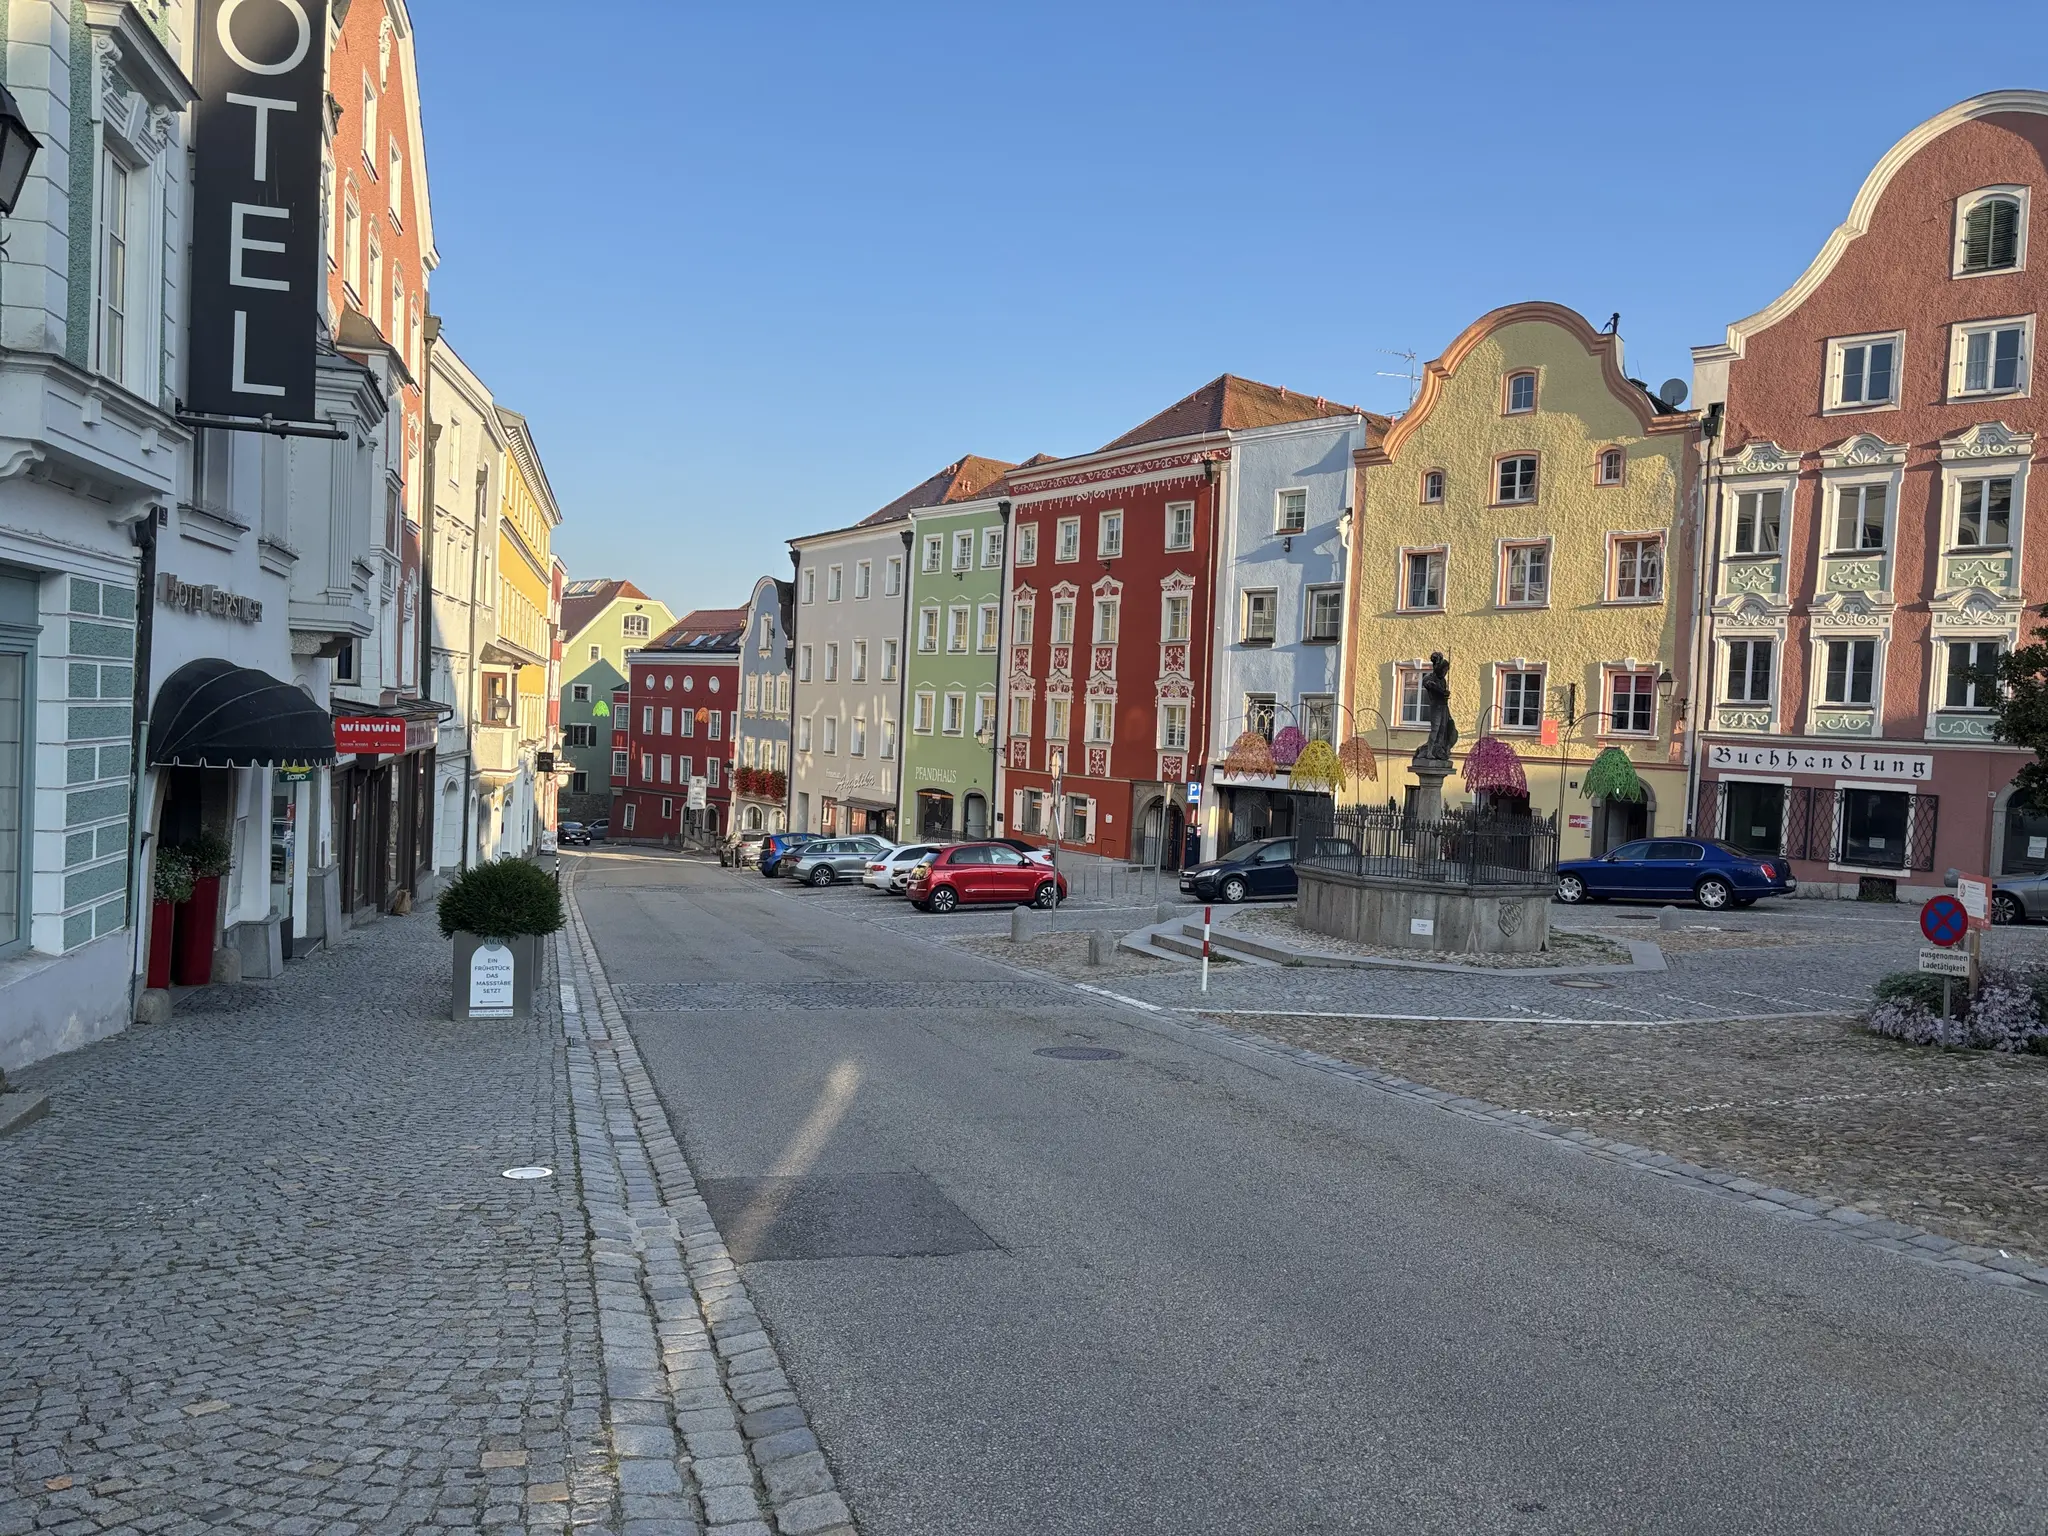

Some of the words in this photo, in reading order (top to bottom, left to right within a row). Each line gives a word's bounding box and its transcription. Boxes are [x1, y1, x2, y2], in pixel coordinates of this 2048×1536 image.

[1714, 747, 1925, 778] Buchhandlung
[915, 766, 957, 783] PFANDHAUS
[1190, 783, 1197, 796] P
[1920, 950, 1968, 962] ausgenommen
[1922, 960, 1966, 973] Ladetätigkeit
